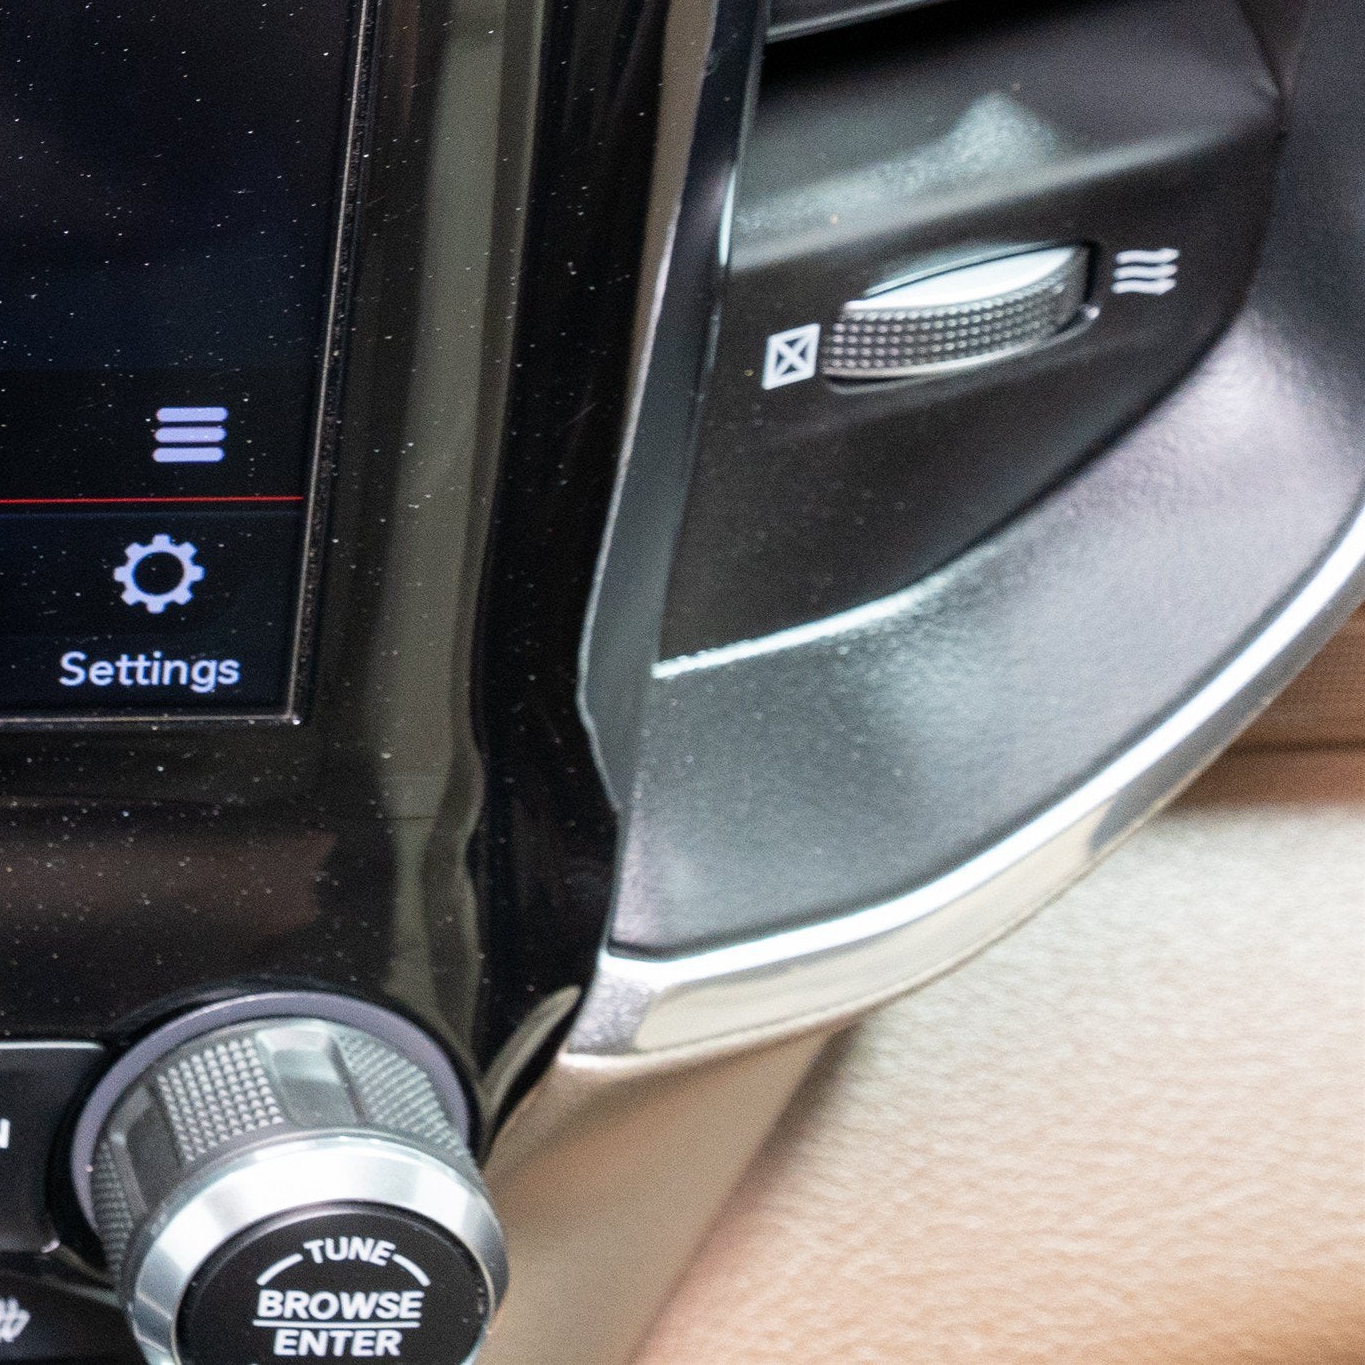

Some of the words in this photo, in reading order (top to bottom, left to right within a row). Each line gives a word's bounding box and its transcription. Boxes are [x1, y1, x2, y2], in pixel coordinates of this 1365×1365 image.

[59, 651, 241, 693] Settings
[304, 1236, 396, 1267] TUNE
[256, 1289, 425, 1320] BROWSE
[273, 1328, 403, 1357] ENTER
